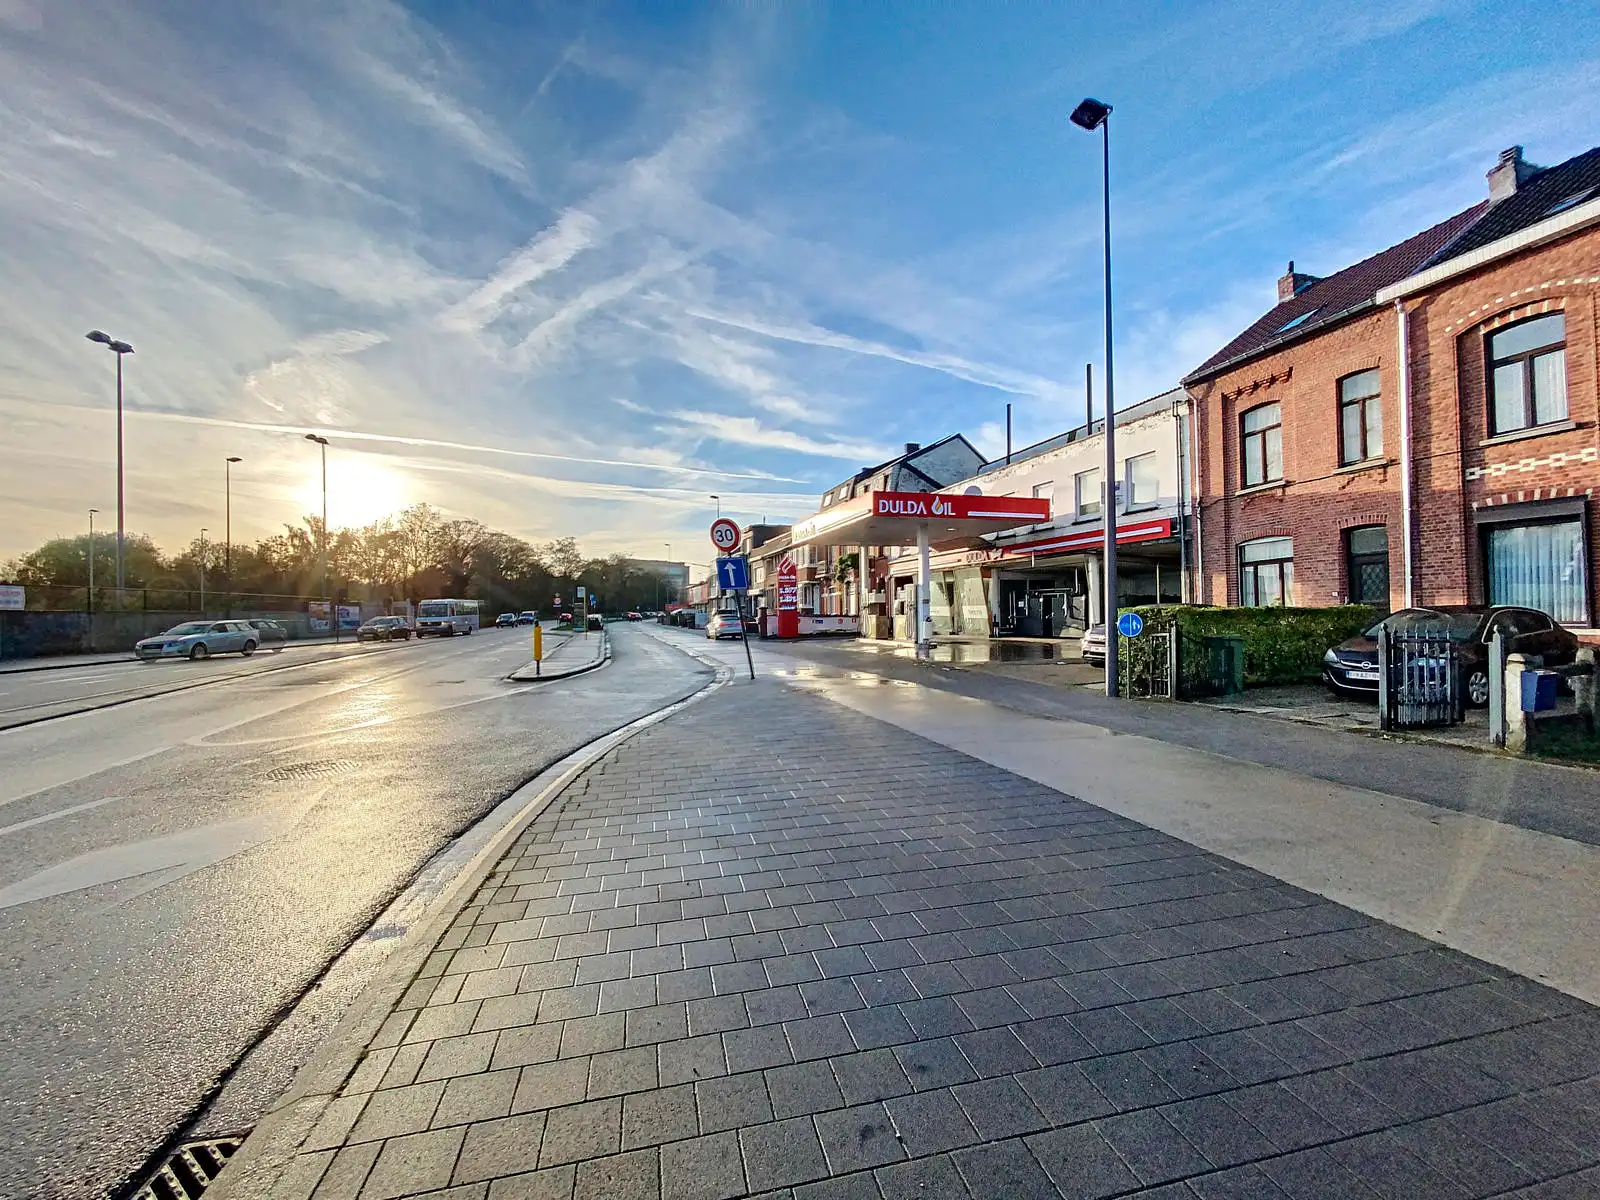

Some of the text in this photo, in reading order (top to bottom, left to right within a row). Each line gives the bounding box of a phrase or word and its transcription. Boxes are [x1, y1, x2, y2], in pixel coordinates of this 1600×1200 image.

[878, 495, 956, 516] DULDA OIL
[715, 528, 734, 543] 30
